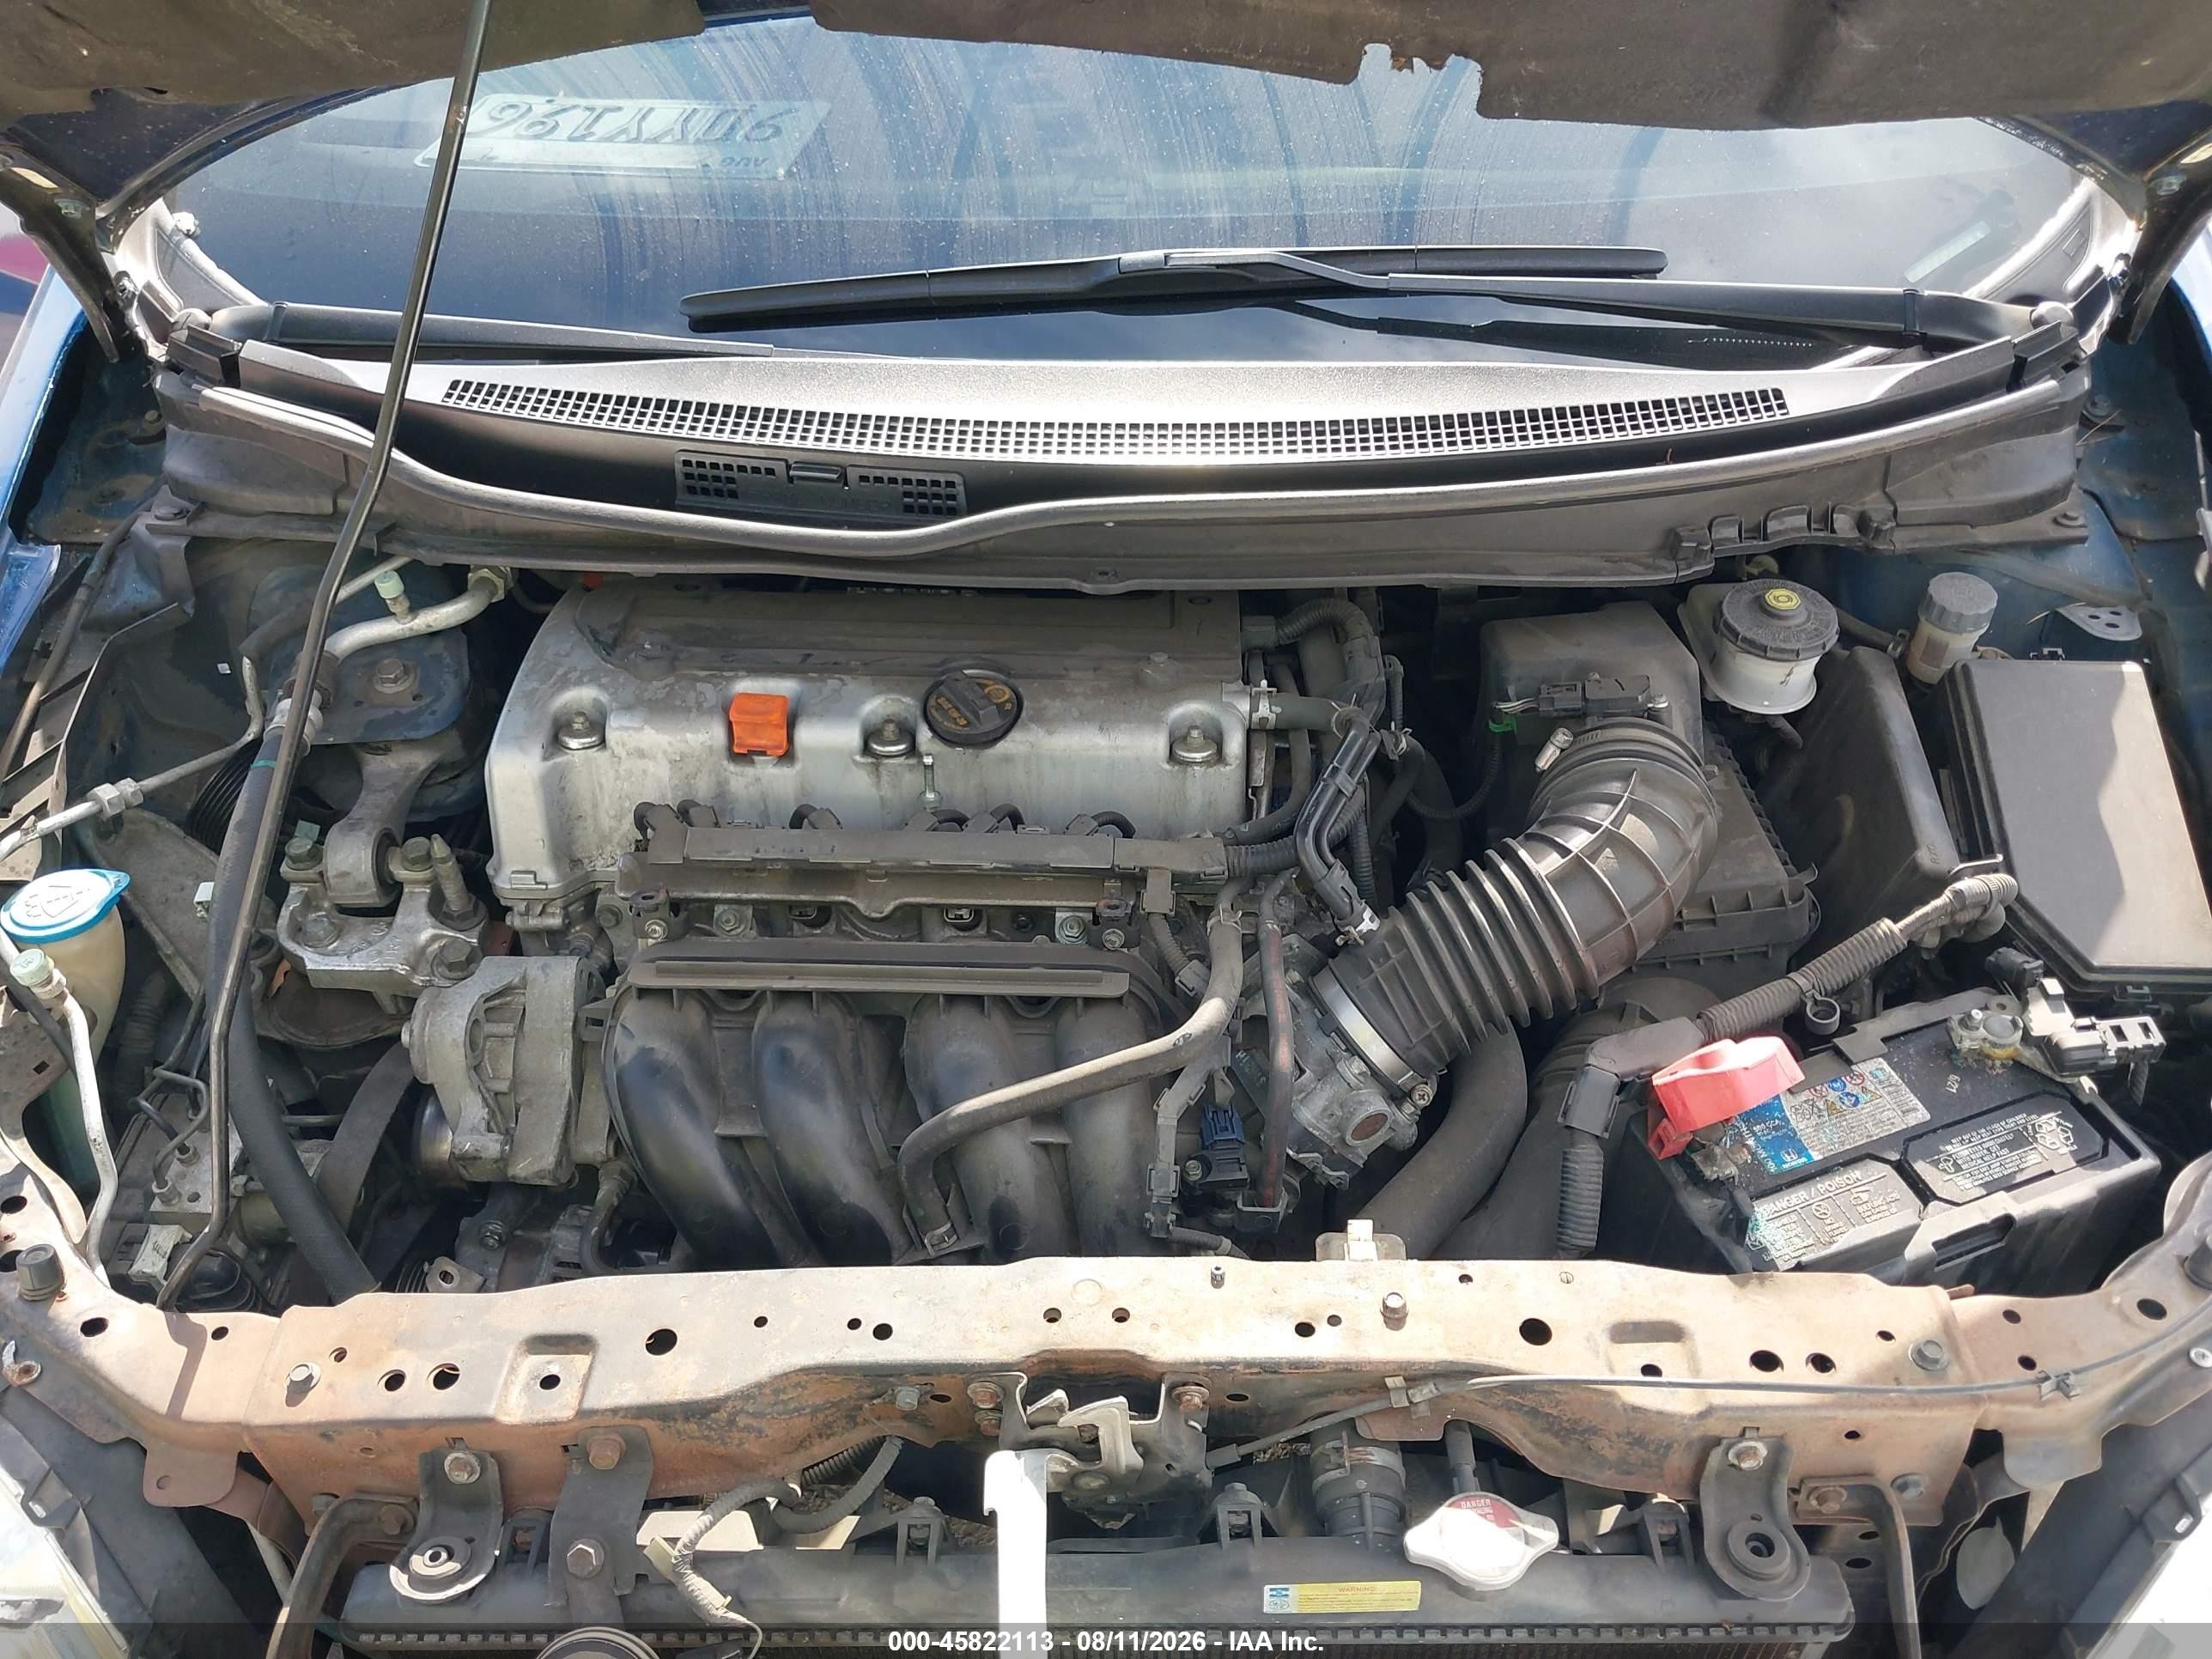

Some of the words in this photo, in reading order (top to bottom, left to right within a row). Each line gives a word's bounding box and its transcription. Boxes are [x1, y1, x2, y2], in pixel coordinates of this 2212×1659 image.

[1782, 1157, 1808, 1170] HONDA
[1818, 1170, 1863, 1195] POISON
[1461, 1498, 1492, 1509] DANGER
